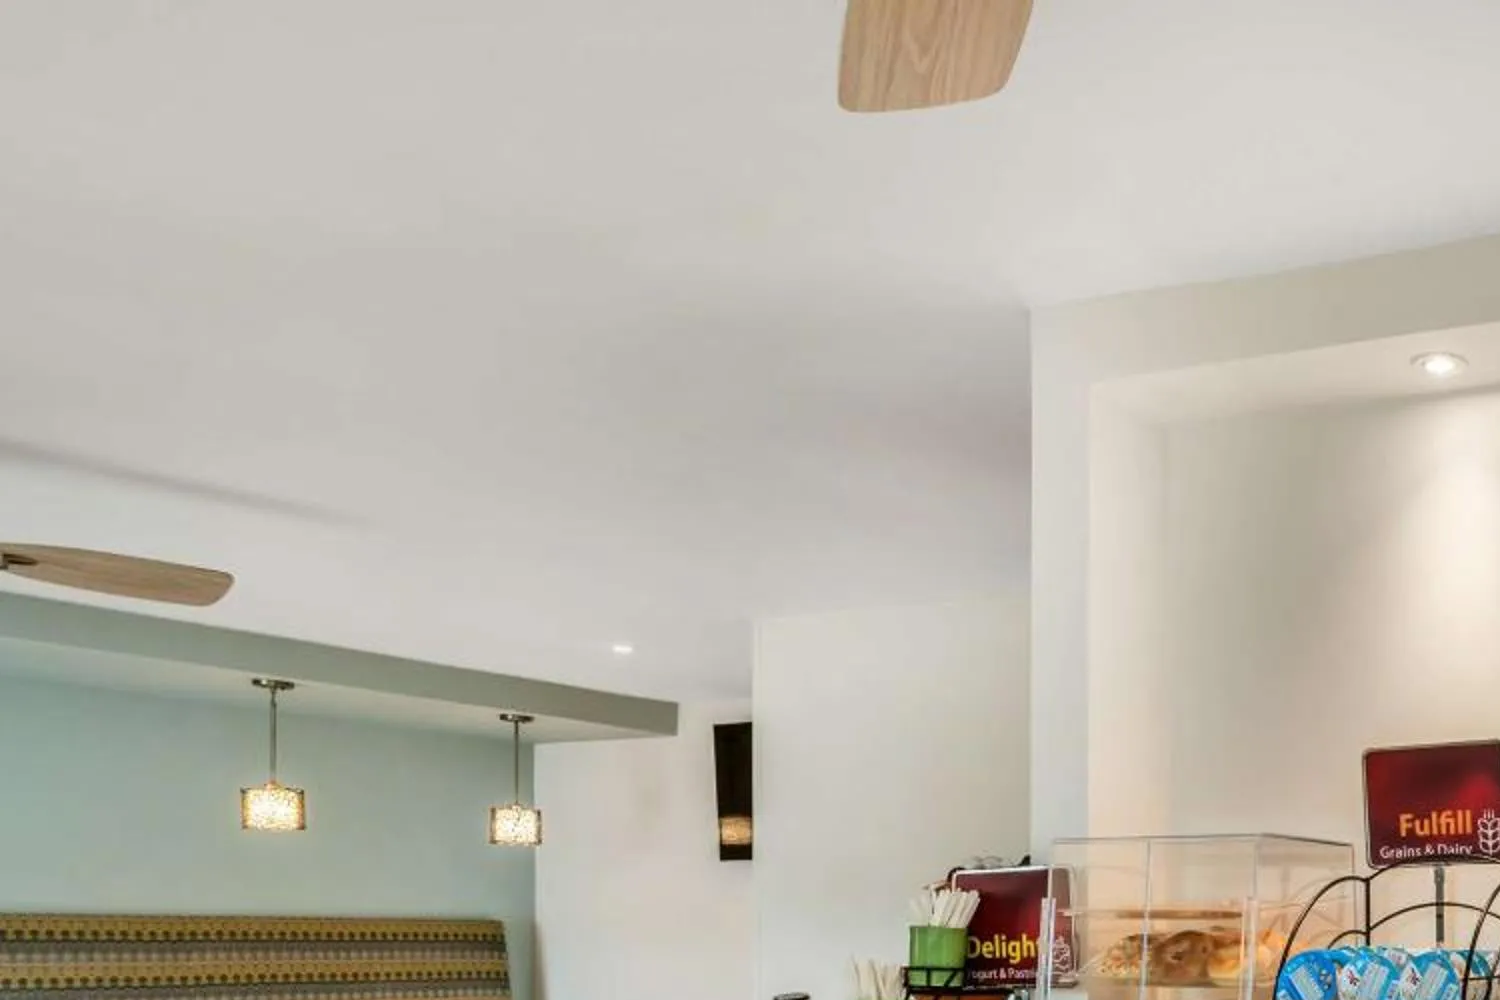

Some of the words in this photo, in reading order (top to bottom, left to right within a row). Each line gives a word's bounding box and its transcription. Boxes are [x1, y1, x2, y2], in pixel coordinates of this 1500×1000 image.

[1399, 809, 1472, 837] Fulfill
[1379, 845, 1421, 859] Grains
[1424, 842, 1435, 855] &
[1437, 842, 1473, 856] Dairy
[1000, 967, 1007, 979] &
